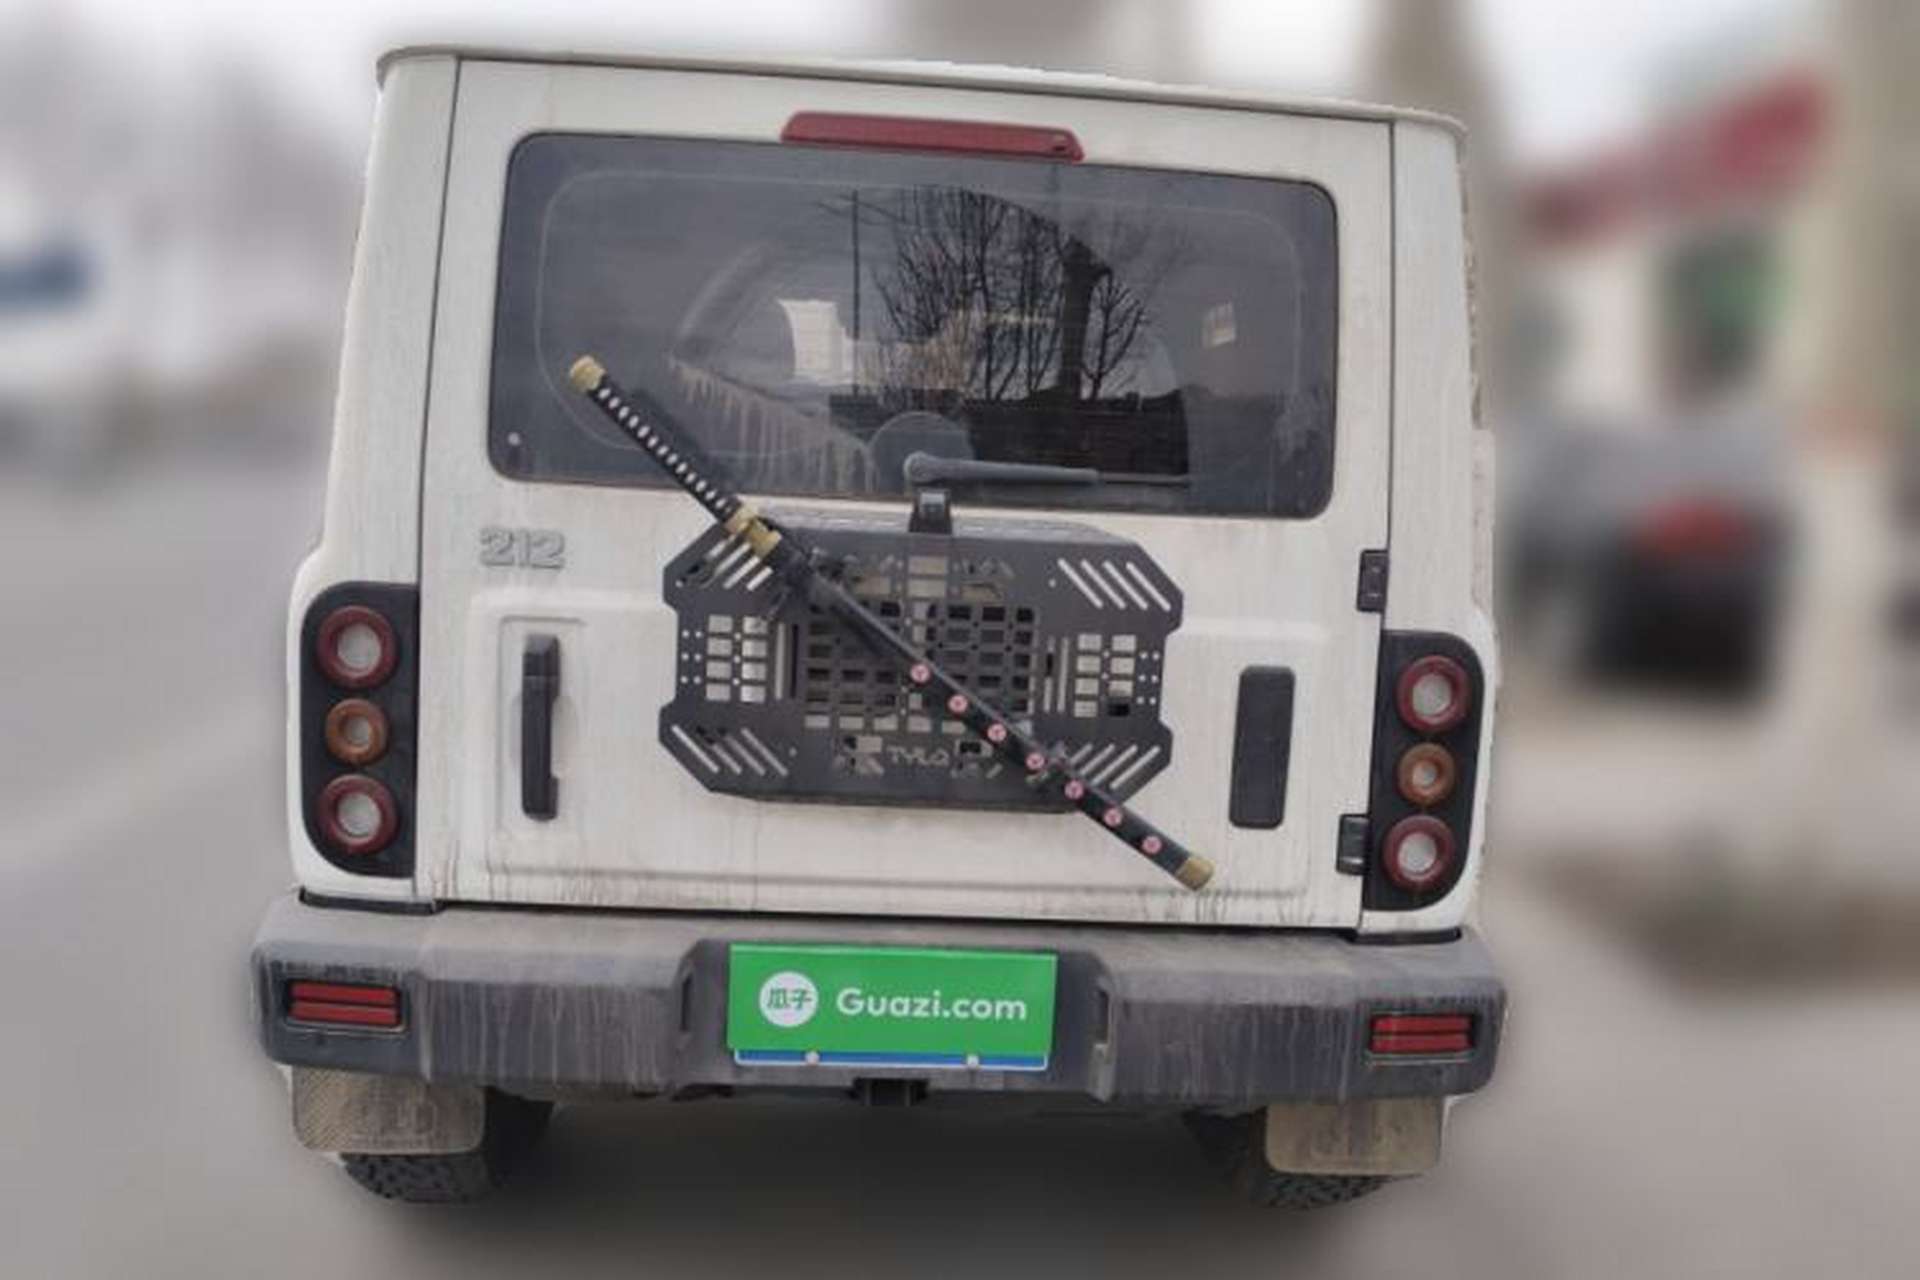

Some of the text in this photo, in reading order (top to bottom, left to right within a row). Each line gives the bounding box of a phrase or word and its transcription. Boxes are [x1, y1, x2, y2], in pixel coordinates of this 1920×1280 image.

[479, 527, 566, 569] 212
[766, 988, 812, 1011] 瓜子
[837, 987, 1027, 1020] Guazi.com
